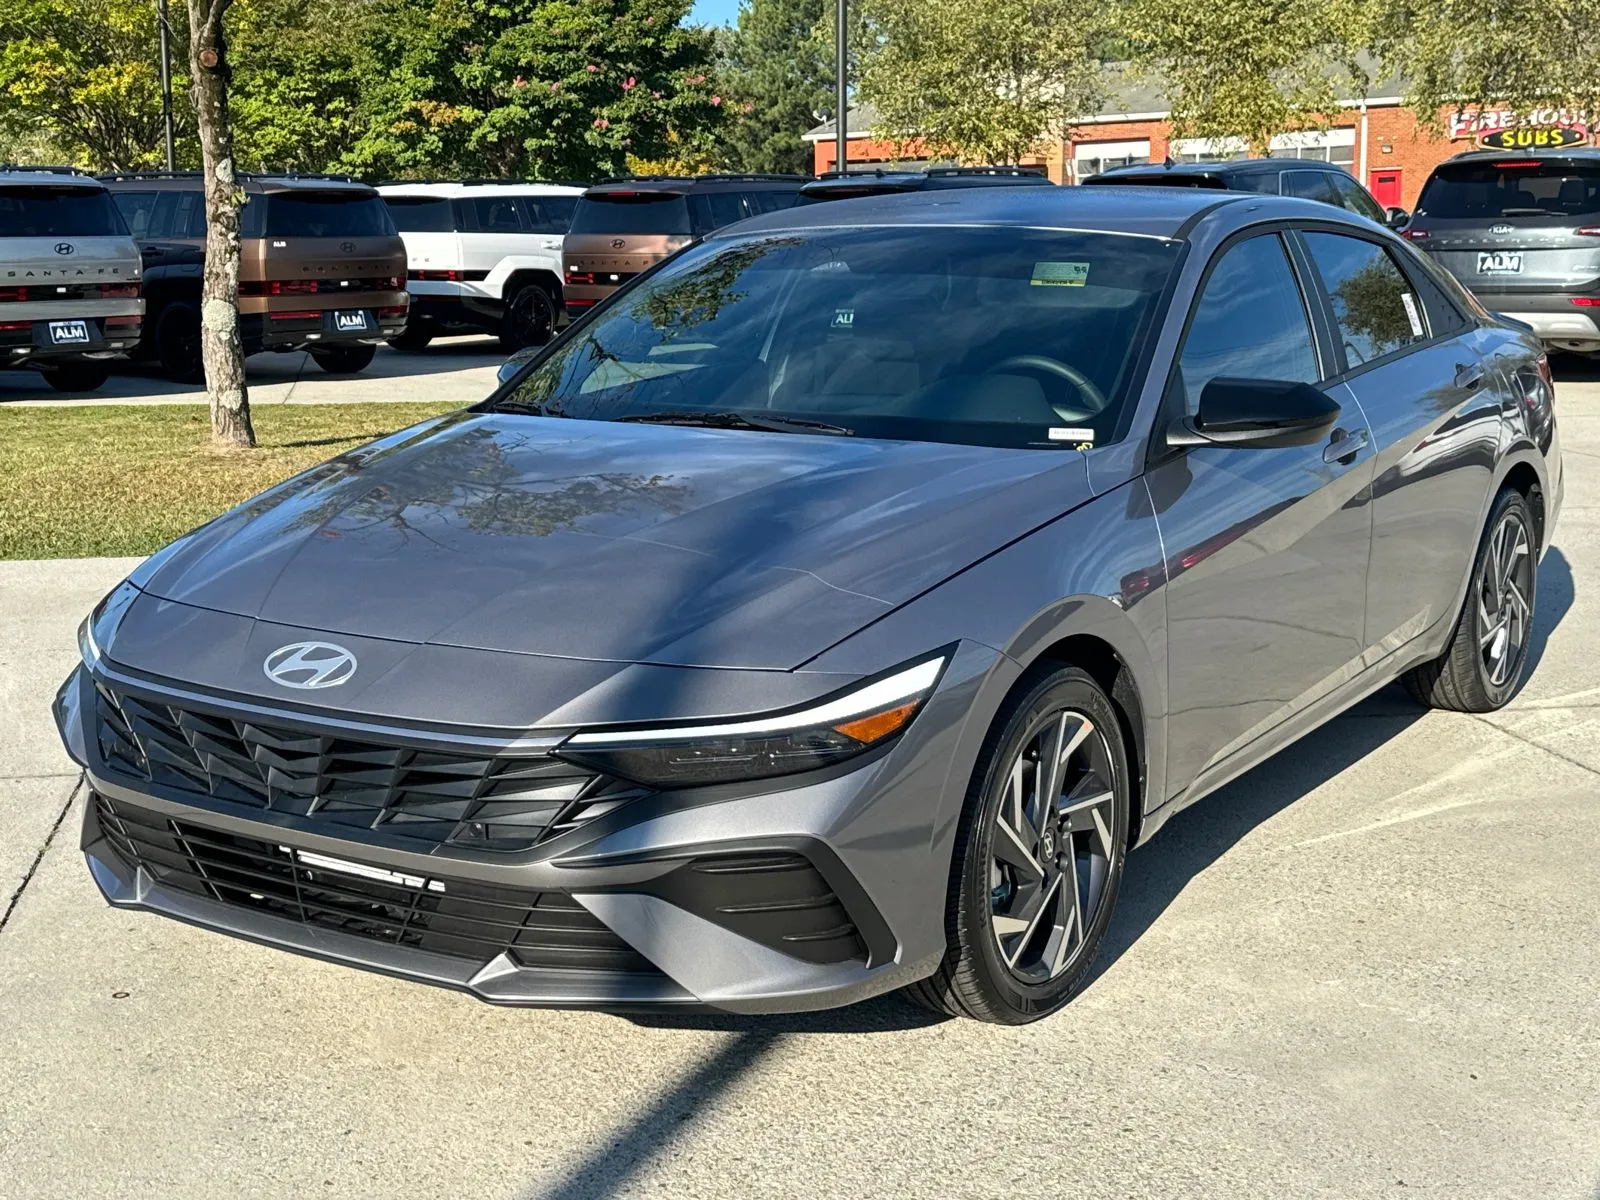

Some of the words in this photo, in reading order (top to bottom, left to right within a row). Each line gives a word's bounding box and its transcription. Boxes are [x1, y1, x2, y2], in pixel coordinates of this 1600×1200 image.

[1502, 129, 1564, 147] SUBS
[1493, 226, 1508, 234] KIA
[1482, 256, 1520, 270] ALM
[8, 269, 84, 277] SANTA
[98, 267, 119, 275] FE
[340, 315, 363, 326] ALM
[56, 325, 84, 339] ALM
